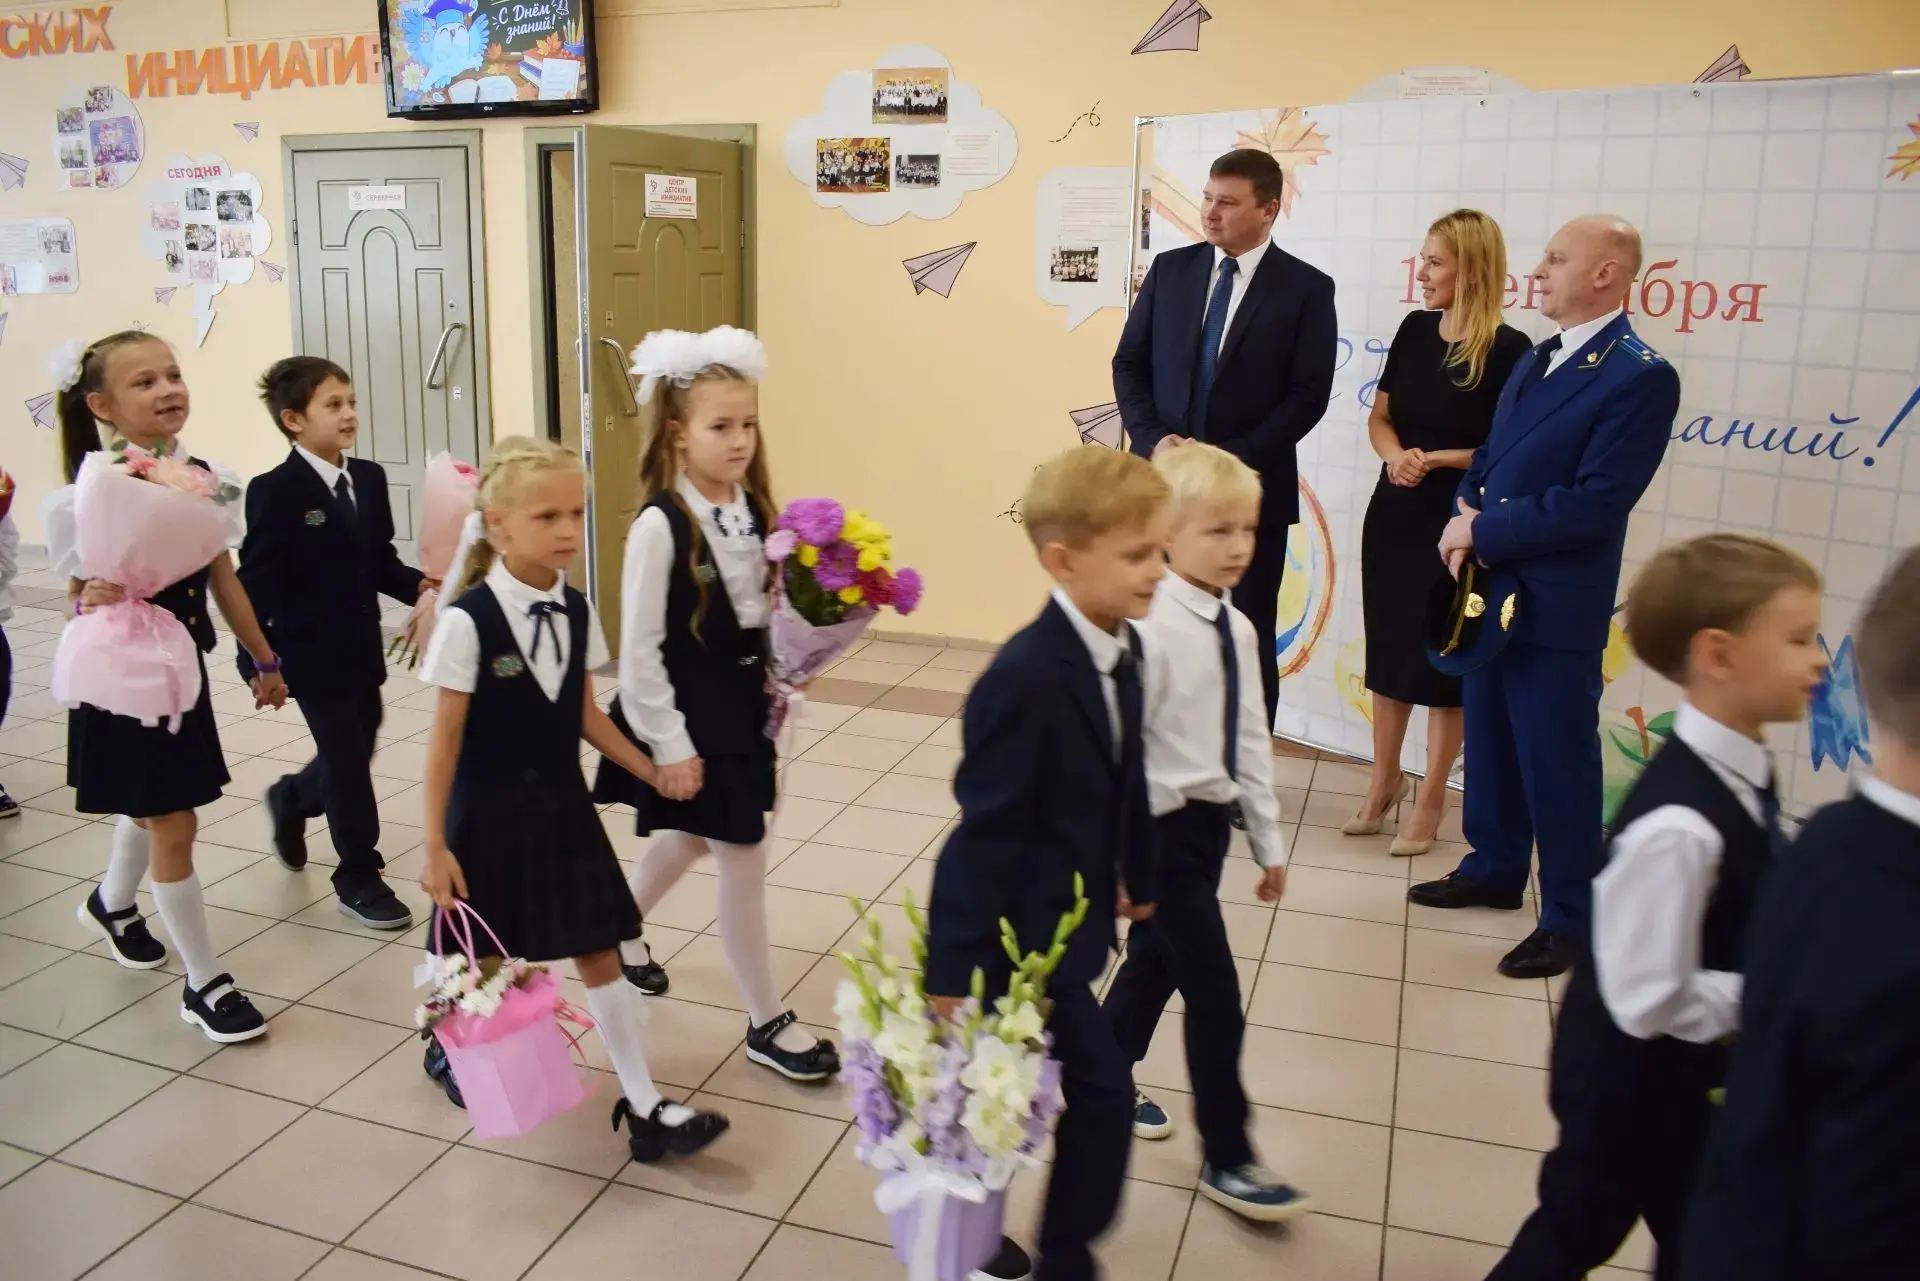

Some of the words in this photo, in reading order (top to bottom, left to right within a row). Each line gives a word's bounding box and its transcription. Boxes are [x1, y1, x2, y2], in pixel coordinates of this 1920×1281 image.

[499, 6, 509, 25] С
[512, 3, 551, 22] Днём
[505, 14, 556, 44] знаний!
[167, 165, 222, 180] СЕГОДНЯ
[660, 194, 692, 202] ИНИЦИАТИВ
[1399, 255, 1421, 304] 1
[1669, 384, 1920, 468] аний!
